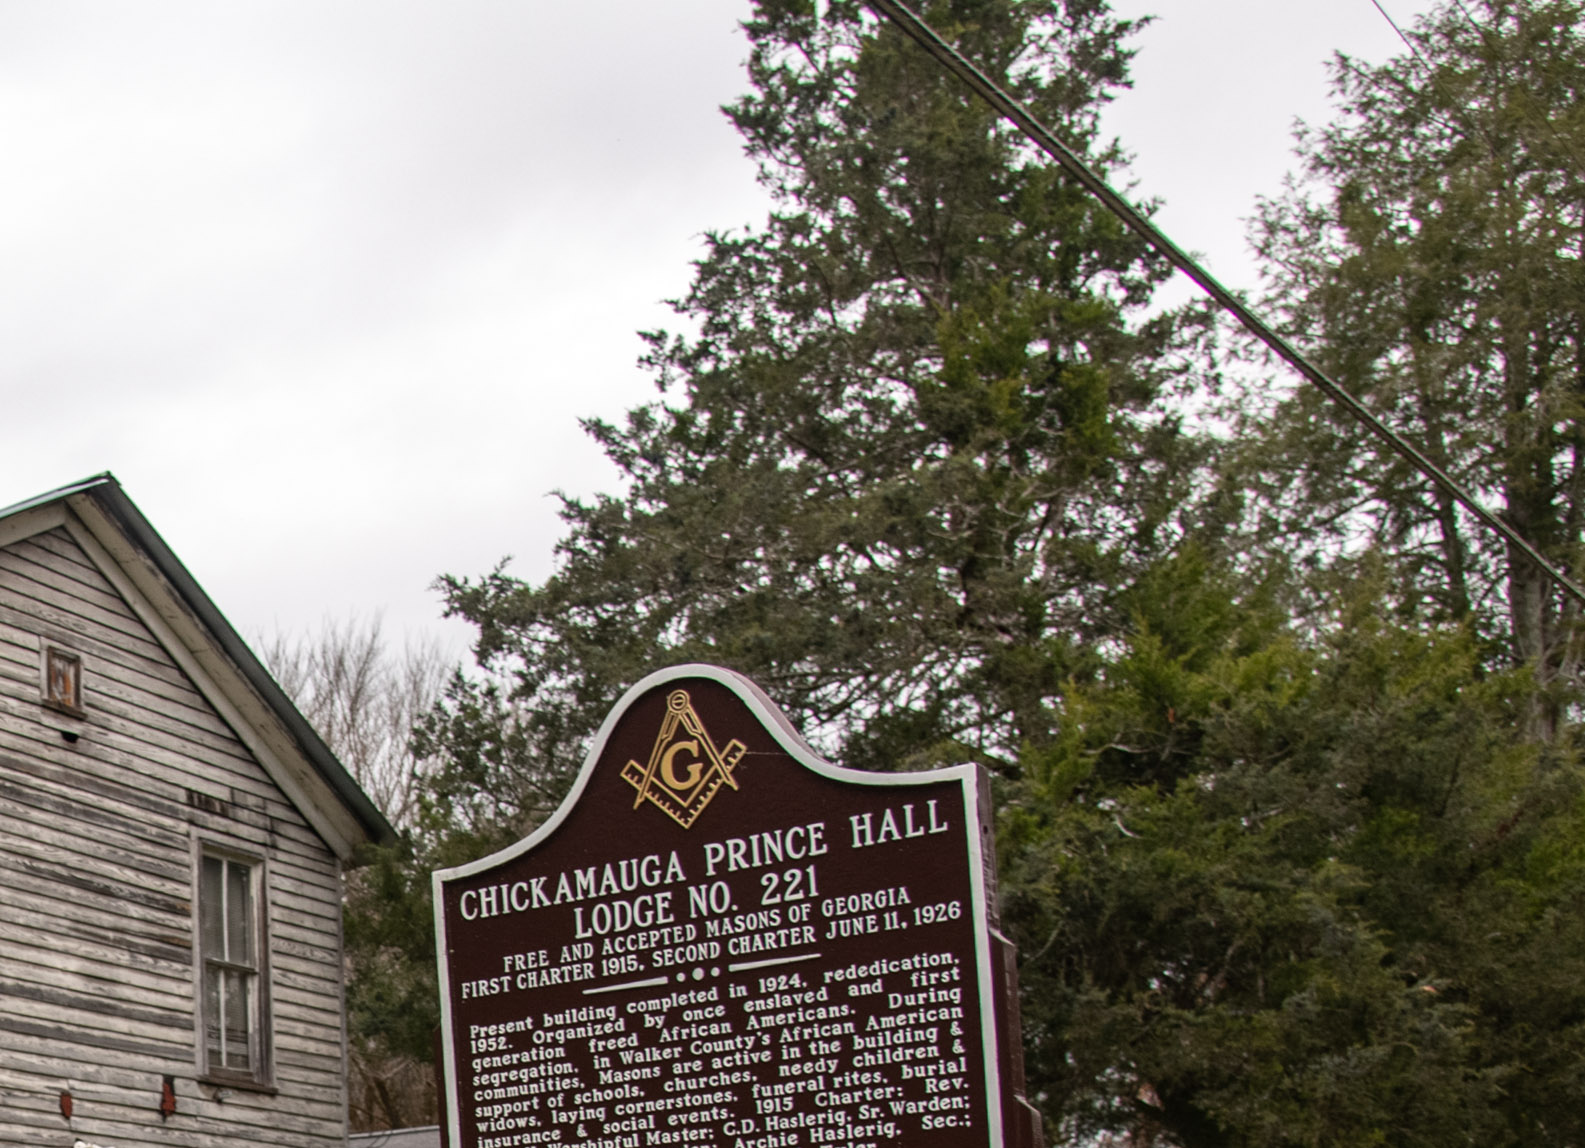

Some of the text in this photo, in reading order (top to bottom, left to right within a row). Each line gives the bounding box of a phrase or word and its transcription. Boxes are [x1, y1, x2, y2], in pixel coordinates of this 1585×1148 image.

[660, 740, 704, 791] G
[459, 799, 948, 921] CHICKAMAUGA PRINCE HALL
[503, 886, 911, 973] FREE AND ACCEPTED MASONS OF GEORGIA
[573, 864, 819, 940] LODGE NO. 221
[461, 900, 962, 1000] FIRST CHARTER 1915, SECOND CHARTER JUNE 11, 1926
[469, 952, 960, 1039] Present building completed in 1924, rededication,
[470, 966, 961, 1055] 1952. Organized by once enslaved and first
[471, 987, 962, 1074] generation freed African Americans. During
[472, 1006, 964, 1088] segregation, in Walker County's African American
[473, 1020, 964, 1102] communities, Masons are active in the building &
[475, 1038, 966, 1119] support of schools, churches, needy children &
[475, 1056, 967, 1133] widows, laying cornerstones, funeral rites, burial
[576, 1123, 588, 1138] &
[602, 1114, 656, 1135] social
[667, 1106, 735, 1126] events.
[755, 1096, 794, 1115] 1915
[814, 1086, 904, 1107] Charter:
[924, 1077, 969, 1094] Rev.
[645, 1127, 715, 1146] Master;
[722, 1118, 761, 1137] C.D.
[764, 1108, 852, 1132] Haslerig,
[858, 1104, 885, 1120] Sr.
[888, 1095, 971, 1116] Warden;
[809, 1120, 902, 1144] Haslerig,
[921, 1114, 972, 1130] Sec.;
